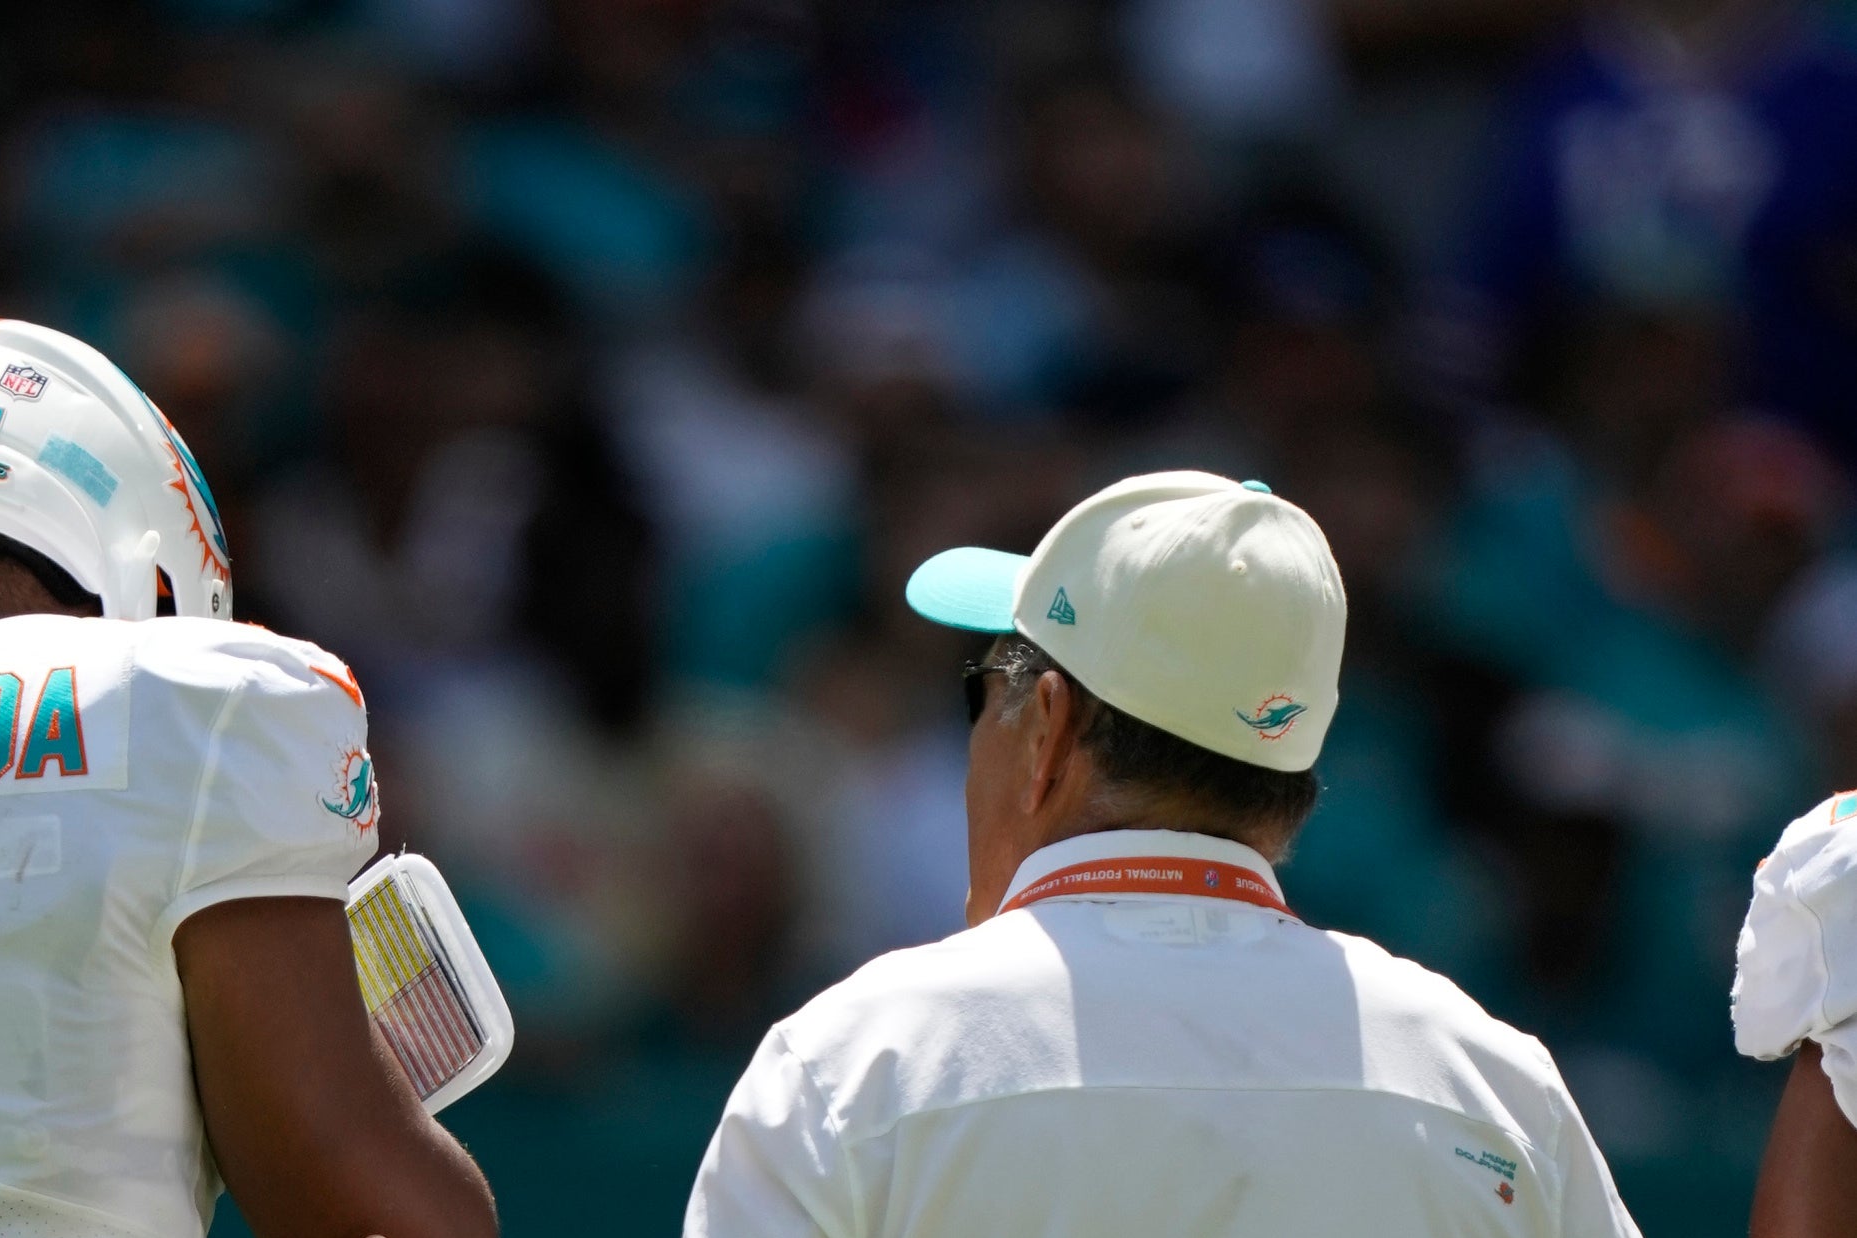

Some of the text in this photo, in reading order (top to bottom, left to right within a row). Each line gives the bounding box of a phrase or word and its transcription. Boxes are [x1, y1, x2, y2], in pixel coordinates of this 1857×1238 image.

[3, 373, 37, 396] NFL
[1062, 868, 1123, 884] FOOTBALL
[1125, 868, 1183, 880] NATIONAL
